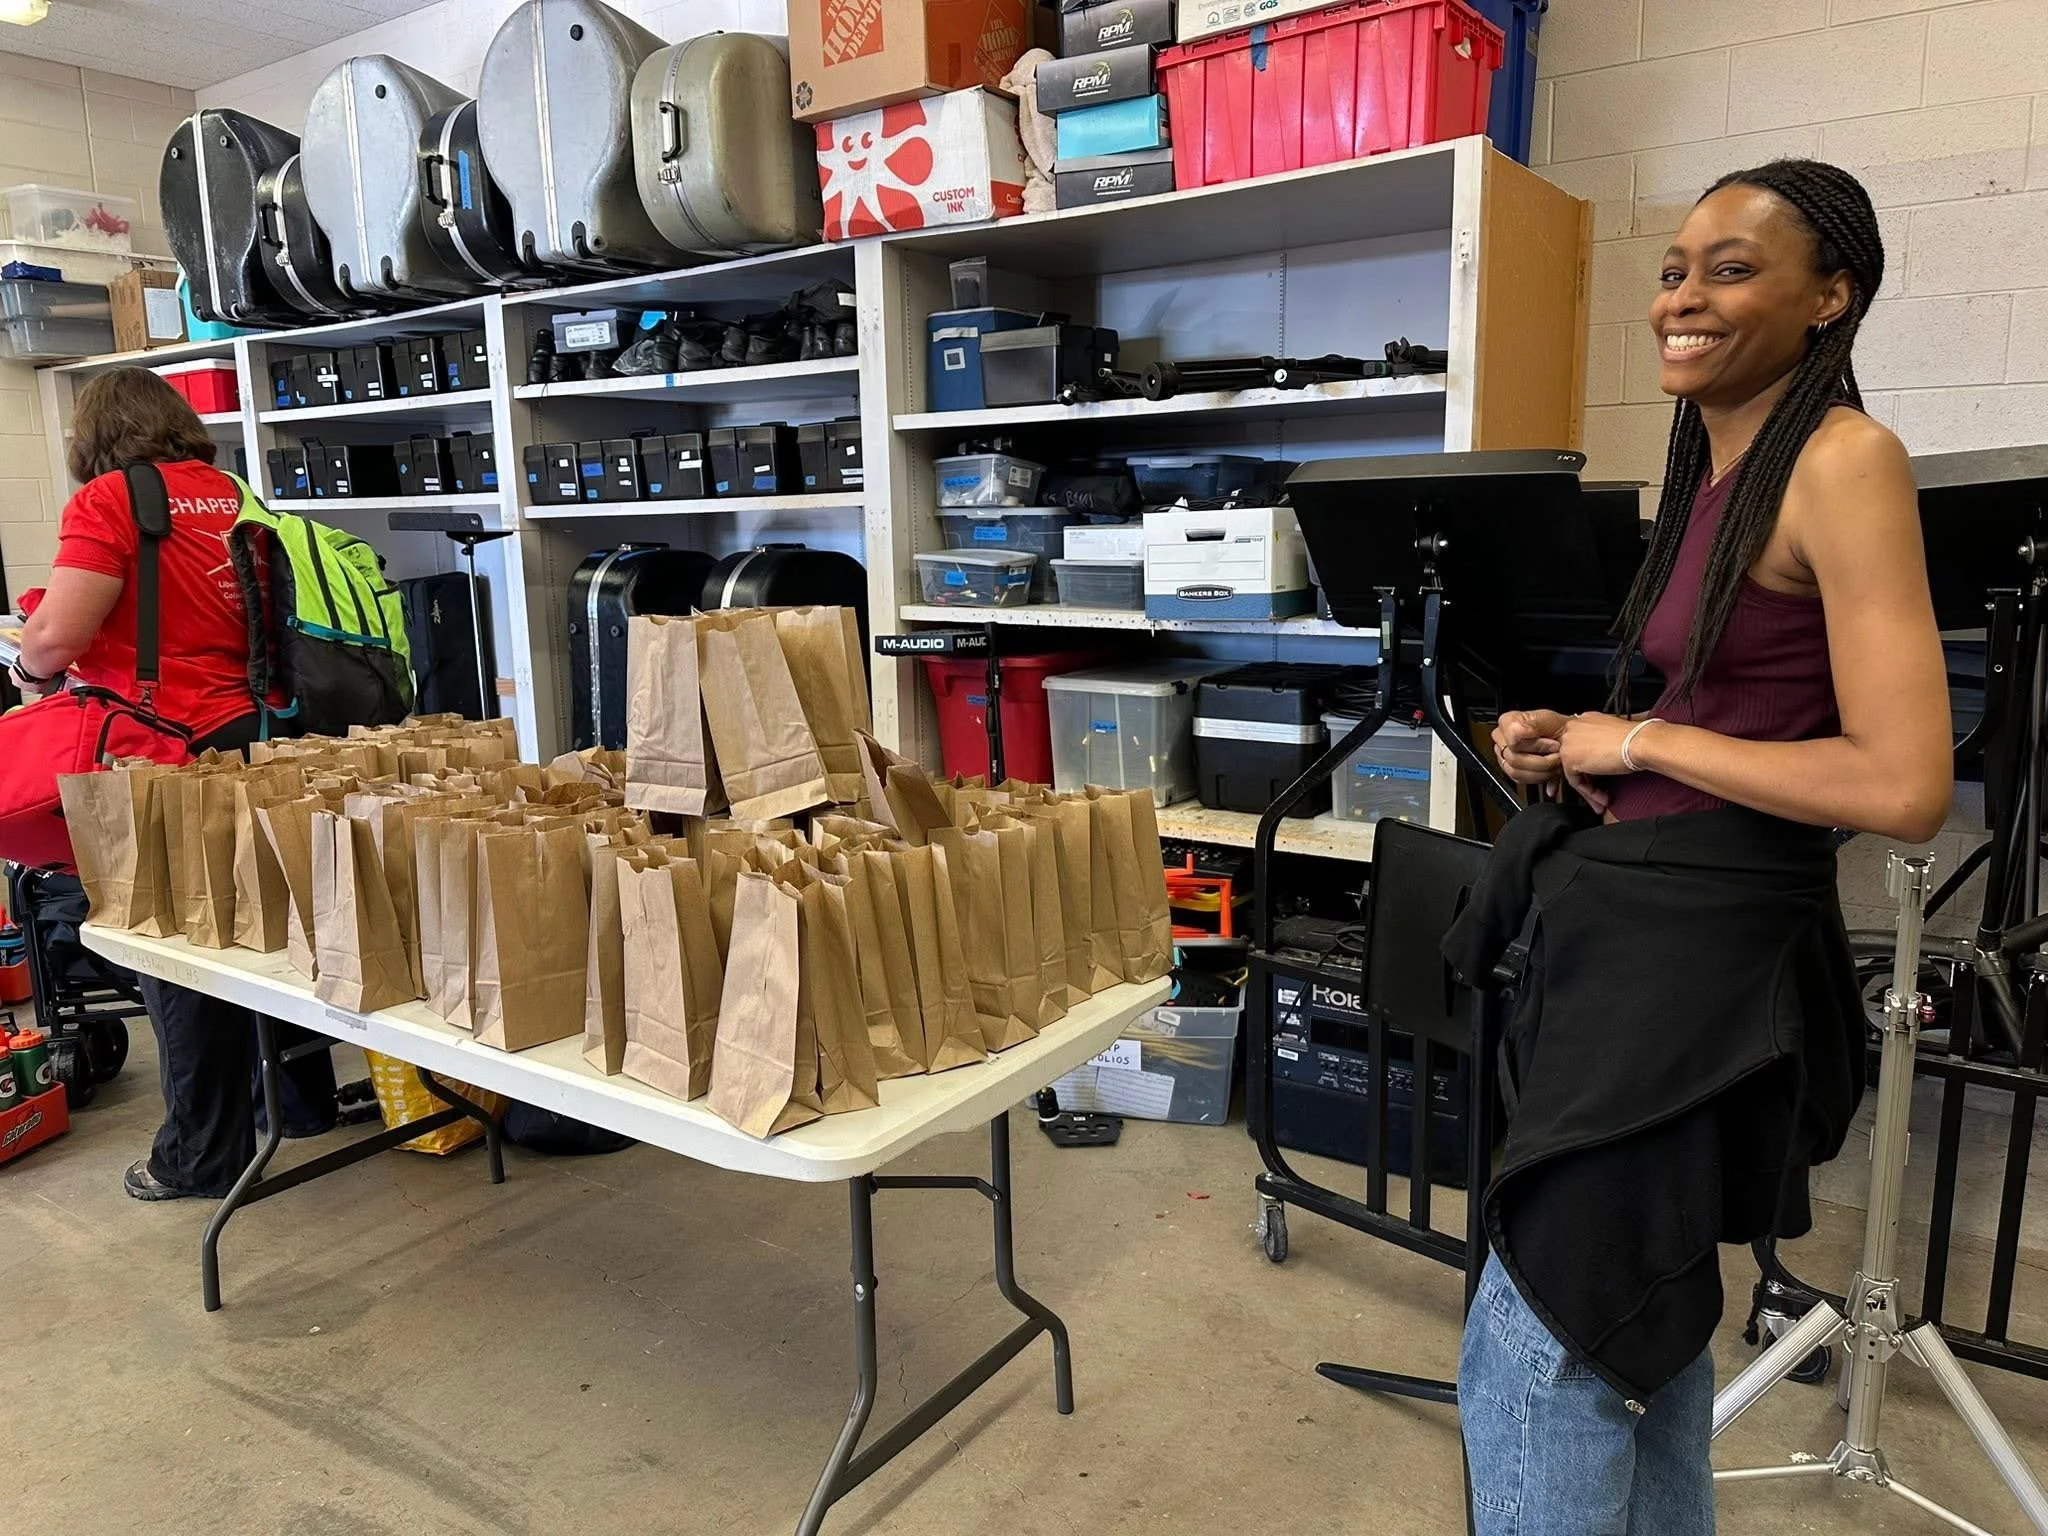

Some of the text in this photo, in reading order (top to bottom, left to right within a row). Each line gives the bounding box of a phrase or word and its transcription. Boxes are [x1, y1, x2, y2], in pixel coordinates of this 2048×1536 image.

[823, 0, 868, 64] HOM
[1098, 20, 1131, 39] RPM
[1073, 73, 1108, 90] RPM
[1094, 174, 1131, 188] RPM
[933, 187, 975, 202] CUSTOM
[947, 202, 965, 214] INK
[168, 497, 240, 514] CHAPER
[883, 638, 944, 649] M-AUDIO
[956, 637, 987, 648] M-AUD
[1312, 984, 1361, 1010] Rola
